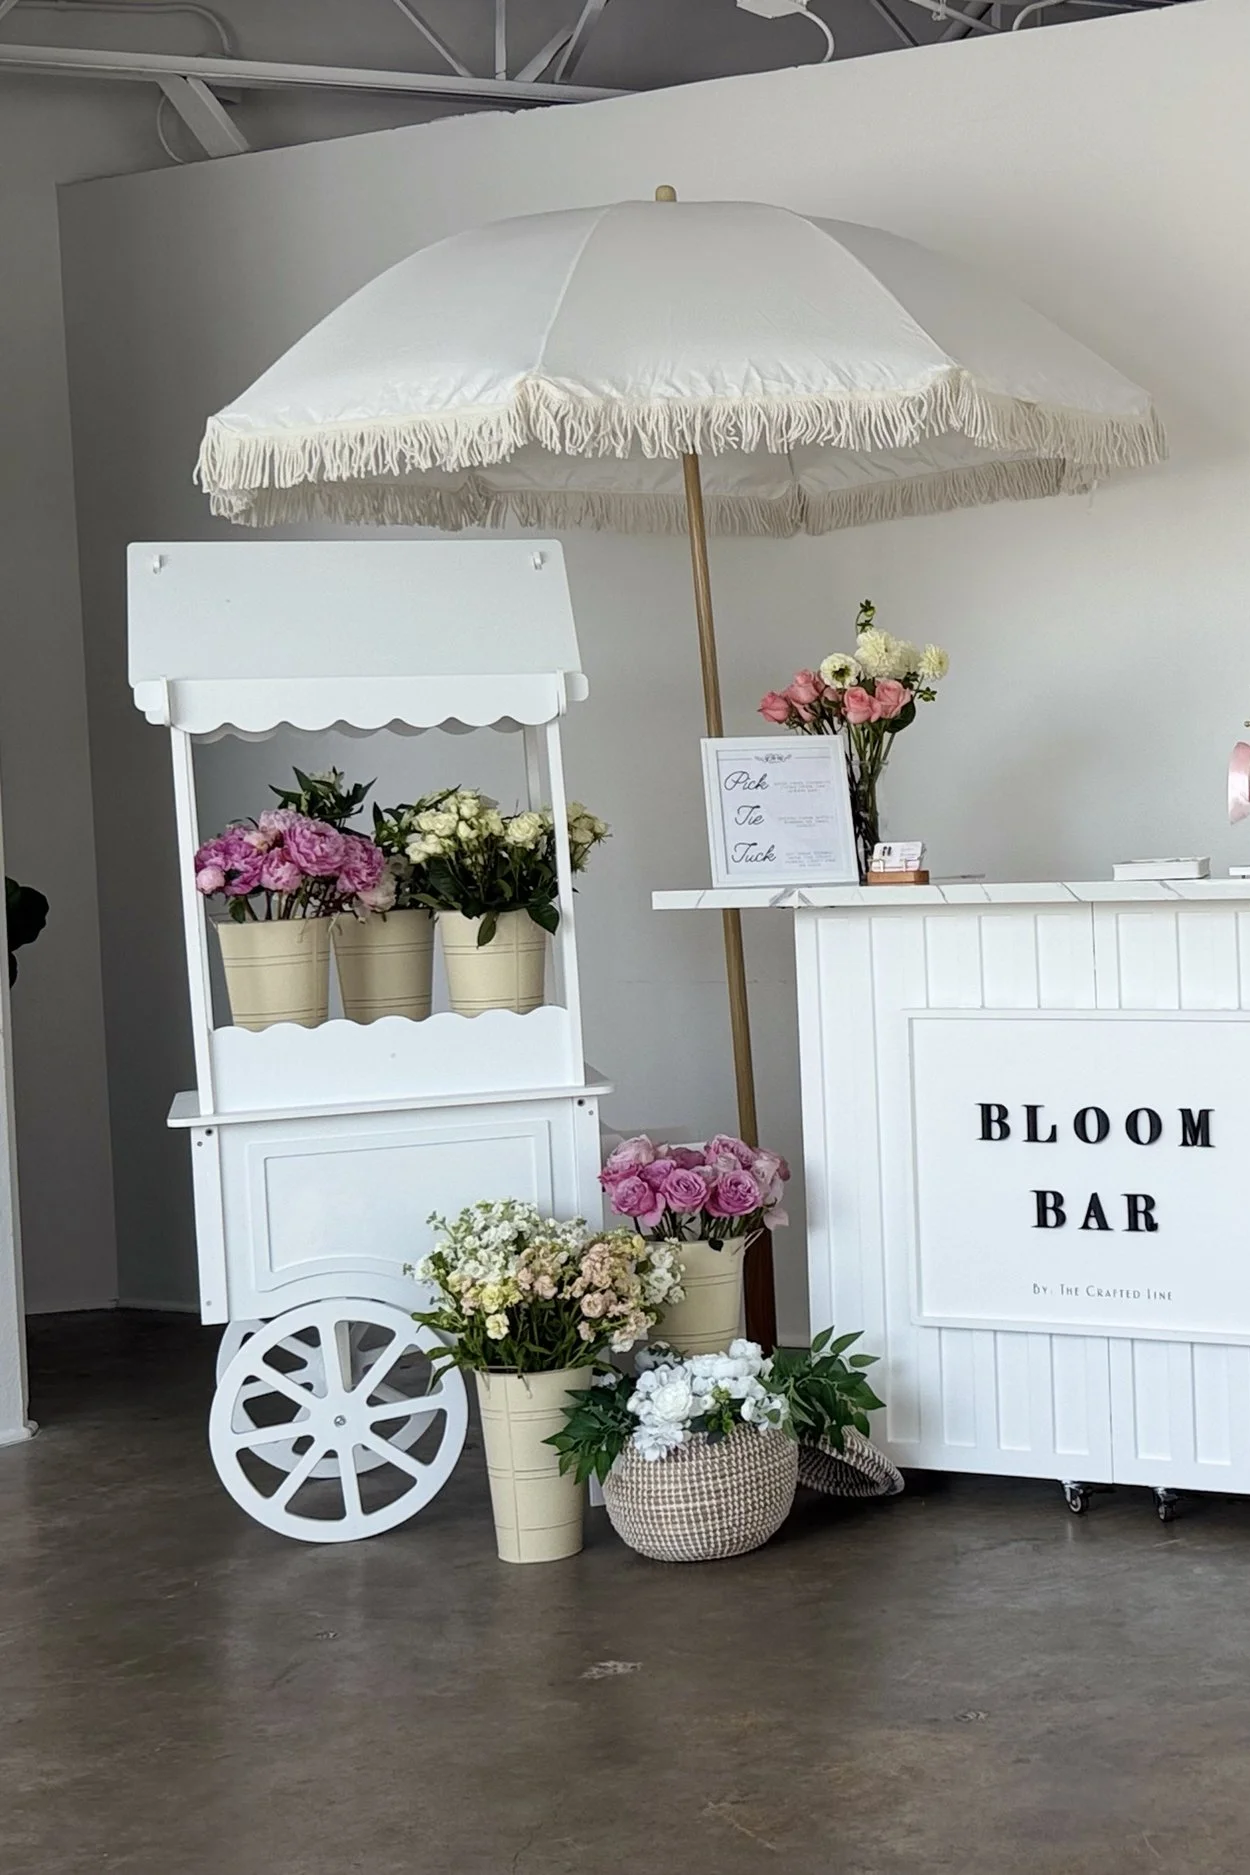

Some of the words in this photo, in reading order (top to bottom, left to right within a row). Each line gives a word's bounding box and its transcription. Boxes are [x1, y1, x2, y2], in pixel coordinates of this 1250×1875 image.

[724, 770, 769, 791] Pick
[734, 804, 765, 827] Tie
[731, 842, 777, 863] Tuck
[975, 1102, 1216, 1149] BLOOM
[1029, 1189, 1160, 1234] BAR
